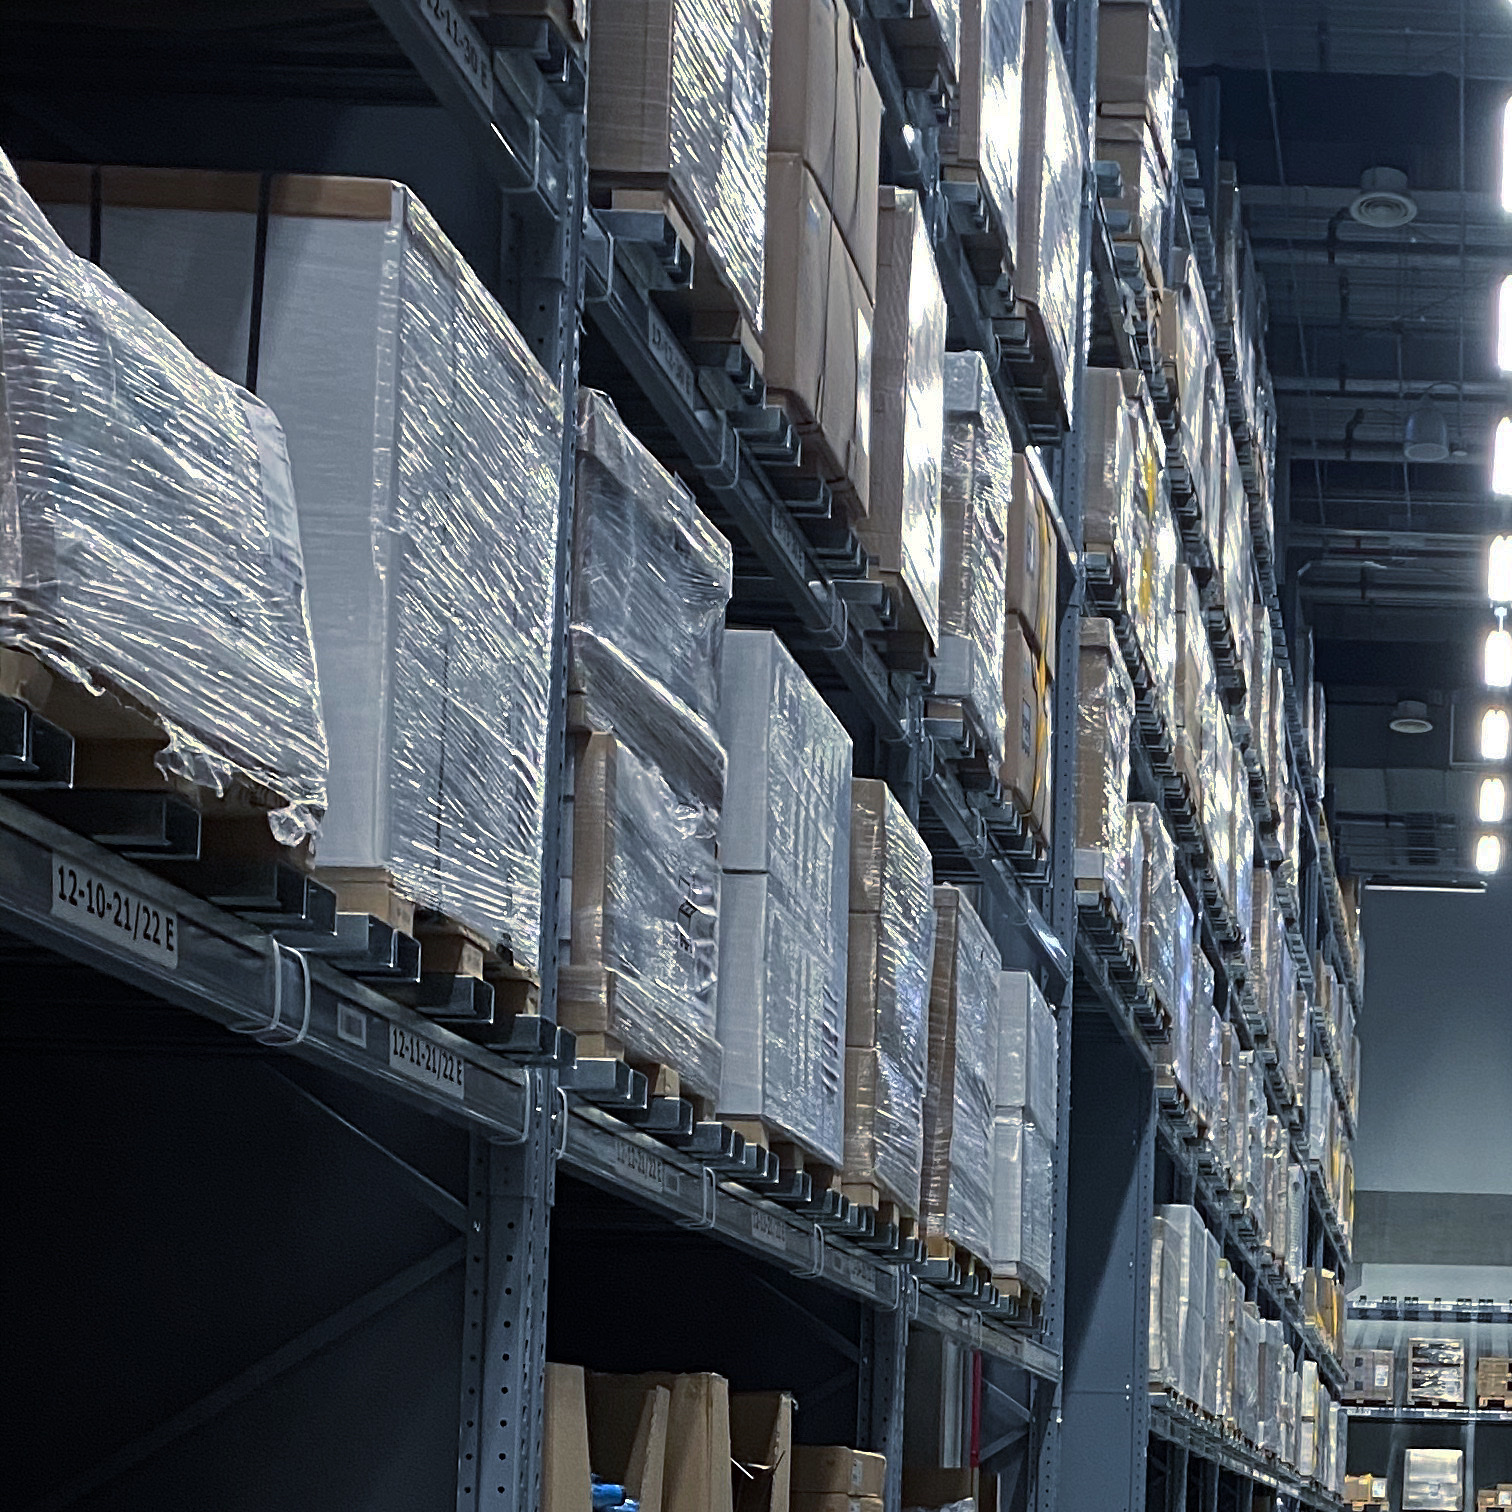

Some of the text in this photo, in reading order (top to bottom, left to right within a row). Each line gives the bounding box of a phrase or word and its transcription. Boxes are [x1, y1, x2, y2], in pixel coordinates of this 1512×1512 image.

[58, 865, 175, 952] 12-10-21/22 E
[393, 1027, 462, 1086] 12-11-21/22 E
